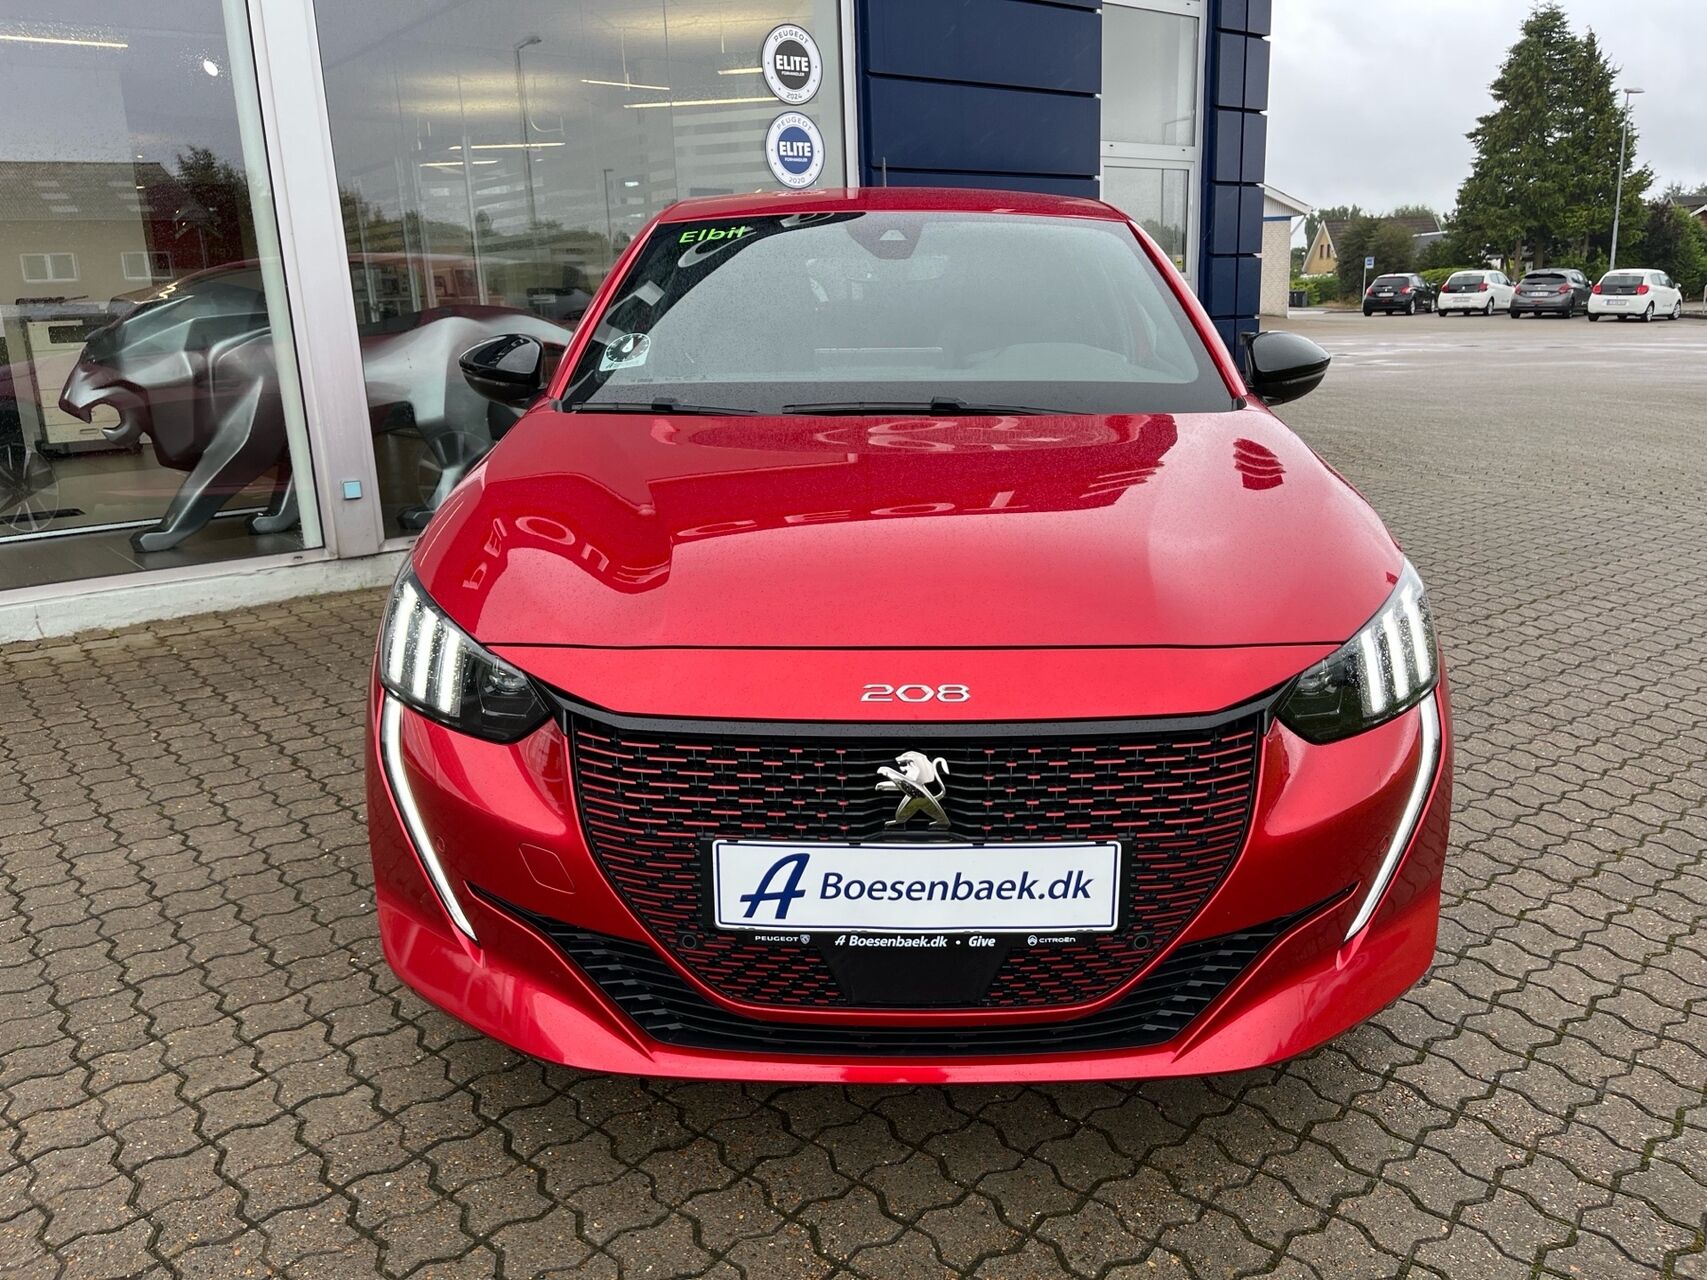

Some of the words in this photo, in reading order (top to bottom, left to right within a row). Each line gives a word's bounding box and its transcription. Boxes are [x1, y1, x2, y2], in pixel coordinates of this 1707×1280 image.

[773, 29, 809, 45] PEUGEOT
[775, 54, 809, 71] ELITE
[776, 116, 813, 131] PEUGEOT
[779, 141, 812, 157] ELITE
[860, 683, 972, 703] 208
[819, 869, 1094, 901] Boesenbaek.dk
[754, 935, 799, 943] PEUGEOT
[849, 934, 948, 948] Boesenbaek.dk
[968, 935, 996, 948] Give
